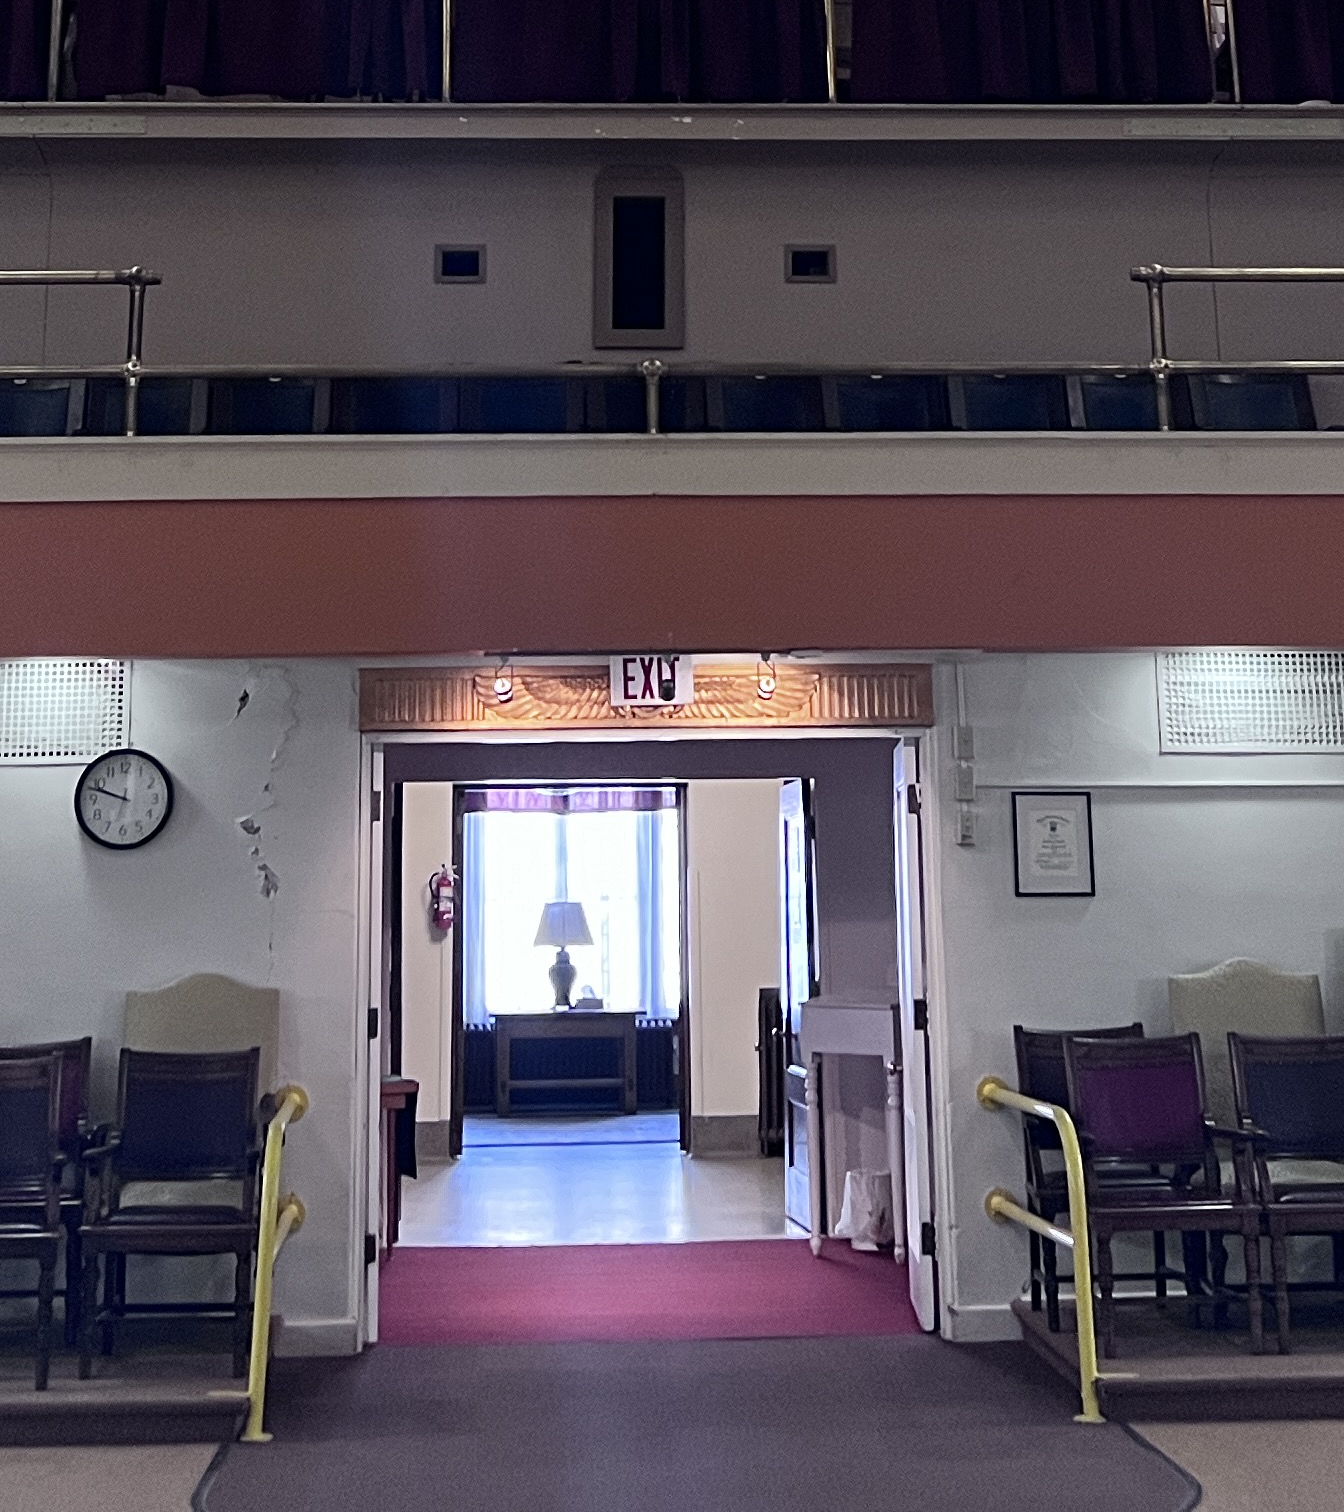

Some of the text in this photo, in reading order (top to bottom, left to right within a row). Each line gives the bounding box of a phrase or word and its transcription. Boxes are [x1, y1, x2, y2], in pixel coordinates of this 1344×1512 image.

[623, 656, 680, 699] EXIT
[106, 766, 115, 778] 11
[120, 761, 131, 775] 12
[94, 777, 106, 790] 10
[147, 776, 155, 789] 2
[89, 793, 98, 806] 9
[151, 792, 159, 805] 3
[93, 808, 102, 820] 8
[104, 820, 112, 834] 7
[118, 824, 128, 836] 6
[135, 820, 143, 833] 5
